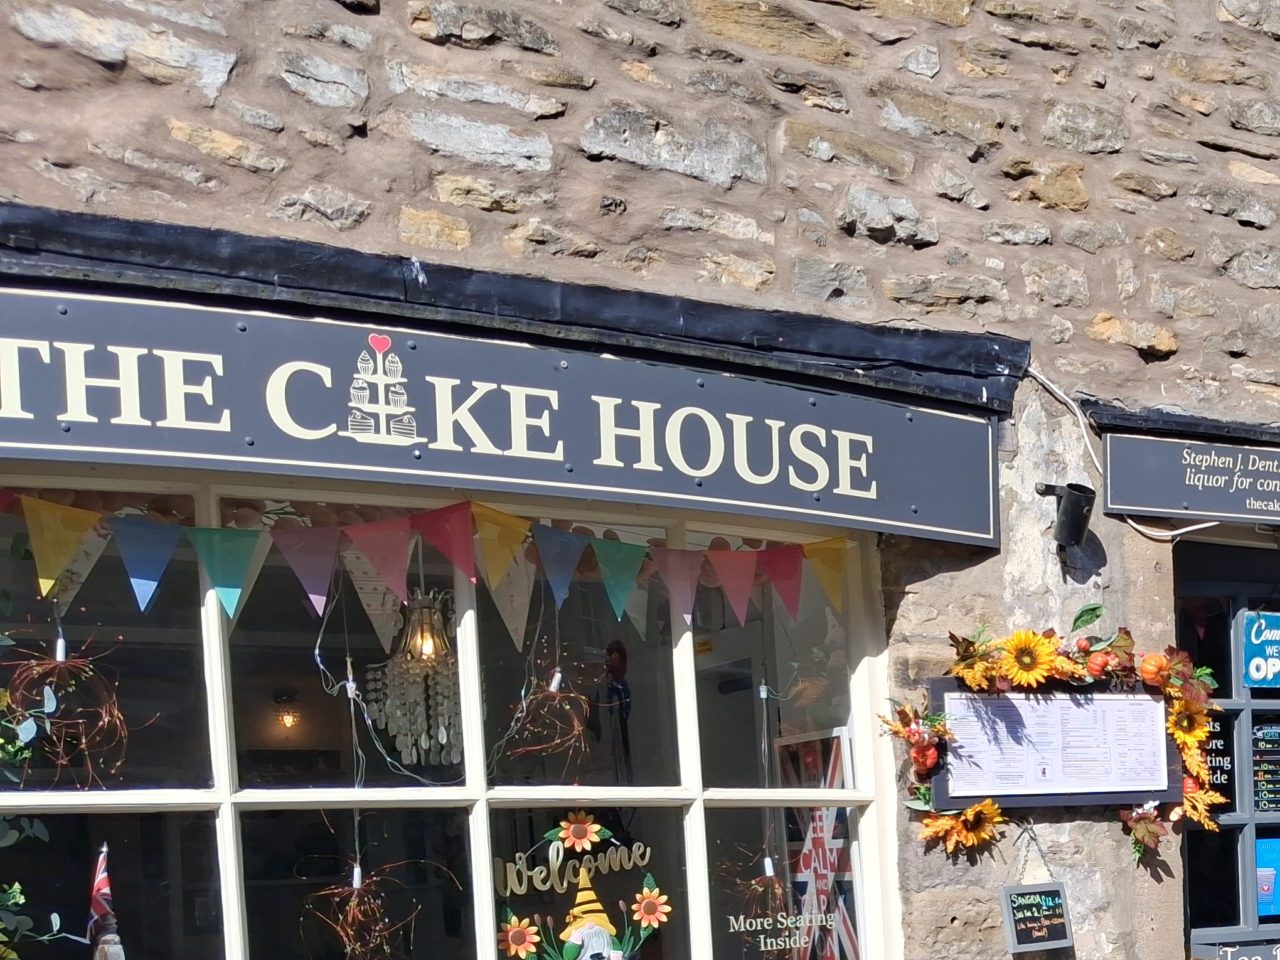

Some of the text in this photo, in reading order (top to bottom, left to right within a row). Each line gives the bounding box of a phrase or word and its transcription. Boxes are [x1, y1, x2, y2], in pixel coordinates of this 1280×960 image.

[0, 337, 231, 432] THE
[591, 395, 877, 499] HOUSE
[1182, 448, 1233, 470] Stephen
[1235, 453, 1244, 472] J.
[1248, 455, 1280, 473] Dent.
[1185, 468, 1228, 490] liquor
[1229, 472, 1253, 492] for
[800, 847, 838, 874] CALM
[728, 912, 836, 932] More Seating
[759, 931, 810, 951] Inside
